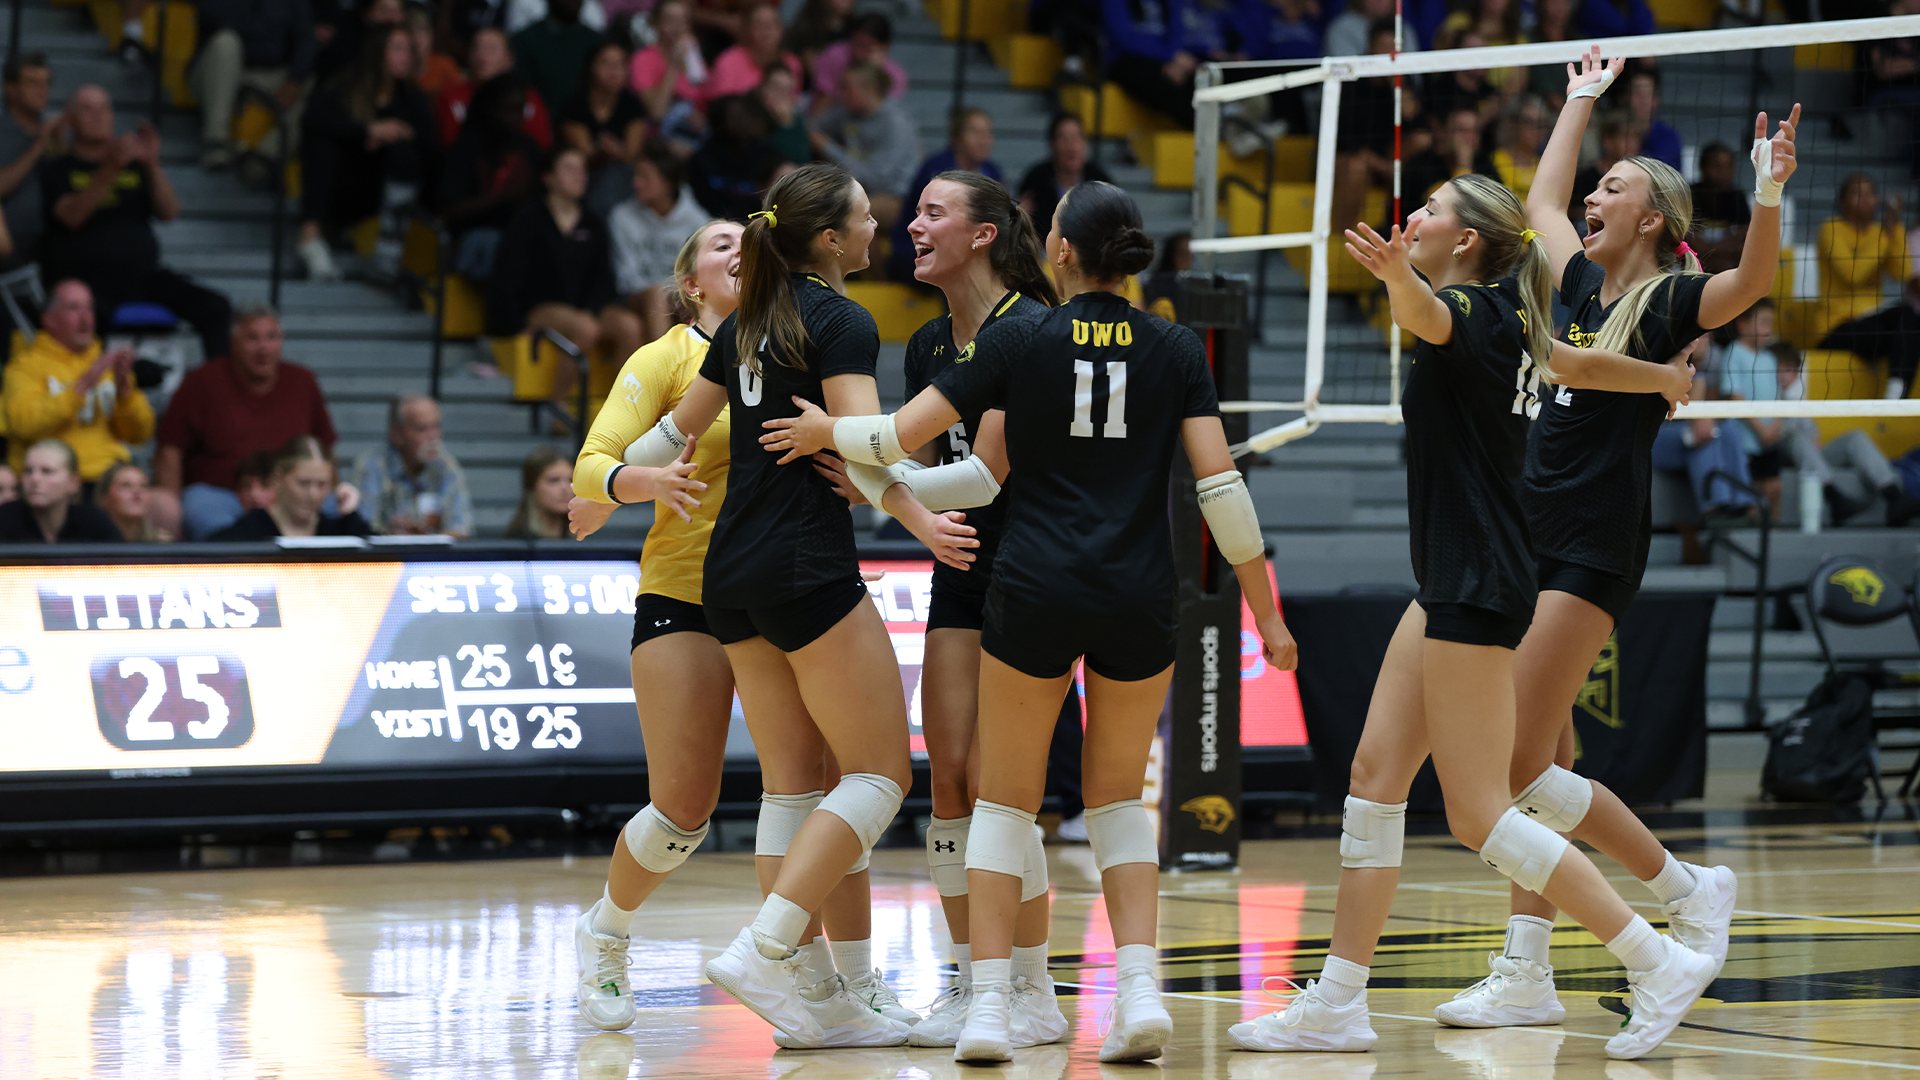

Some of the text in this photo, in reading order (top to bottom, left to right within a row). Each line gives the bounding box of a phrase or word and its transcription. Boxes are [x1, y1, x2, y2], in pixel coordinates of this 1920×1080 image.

[1072, 319, 1133, 347] UWO
[1070, 359, 1127, 438] 11
[57, 577, 260, 629] TITANS
[407, 572, 518, 613] SET 3
[542, 575, 640, 614] 3:00
[365, 661, 439, 689] HOME
[456, 644, 511, 687] 25
[118, 655, 230, 741] 25
[1199, 626, 1220, 773] sports imports
[371, 706, 582, 751] VIST 19 25
